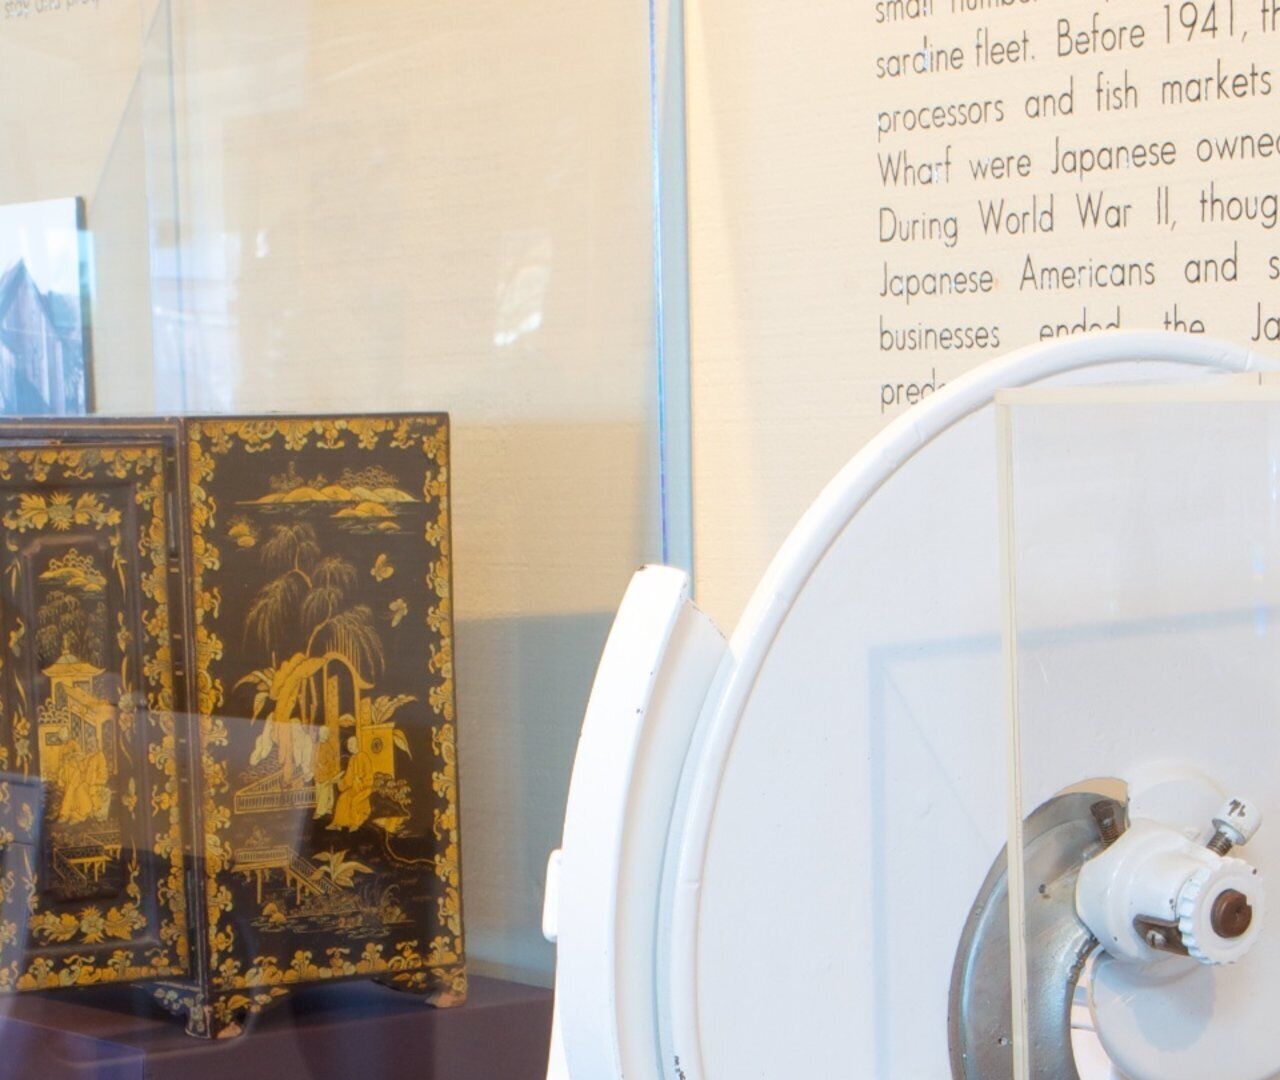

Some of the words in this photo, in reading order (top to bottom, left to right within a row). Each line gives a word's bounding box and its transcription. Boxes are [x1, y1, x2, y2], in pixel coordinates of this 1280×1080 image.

[876, 35, 964, 78] sardine
[975, 27, 1034, 67] fleet.
[1057, 12, 1145, 57] Before
[1165, 2, 1247, 43] 1941,
[878, 99, 1004, 143] processors
[1024, 75, 1074, 119] and
[1095, 69, 1138, 111] fish
[1161, 58, 1271, 104] markets
[877, 144, 951, 186] Wharf
[968, 154, 1031, 180] were
[1051, 136, 1176, 180] Japanese
[879, 206, 958, 248] During
[978, 193, 1054, 235] World
[1075, 190, 1132, 228] War
[1156, 186, 1176, 230] II,
[879, 262, 993, 304] Japanese
[1019, 254, 1155, 290] Americans
[1184, 240, 1237, 284] and
[880, 315, 1000, 351] businesses
[1039, 306, 1121, 341] endd
[1163, 303, 1206, 333] the
